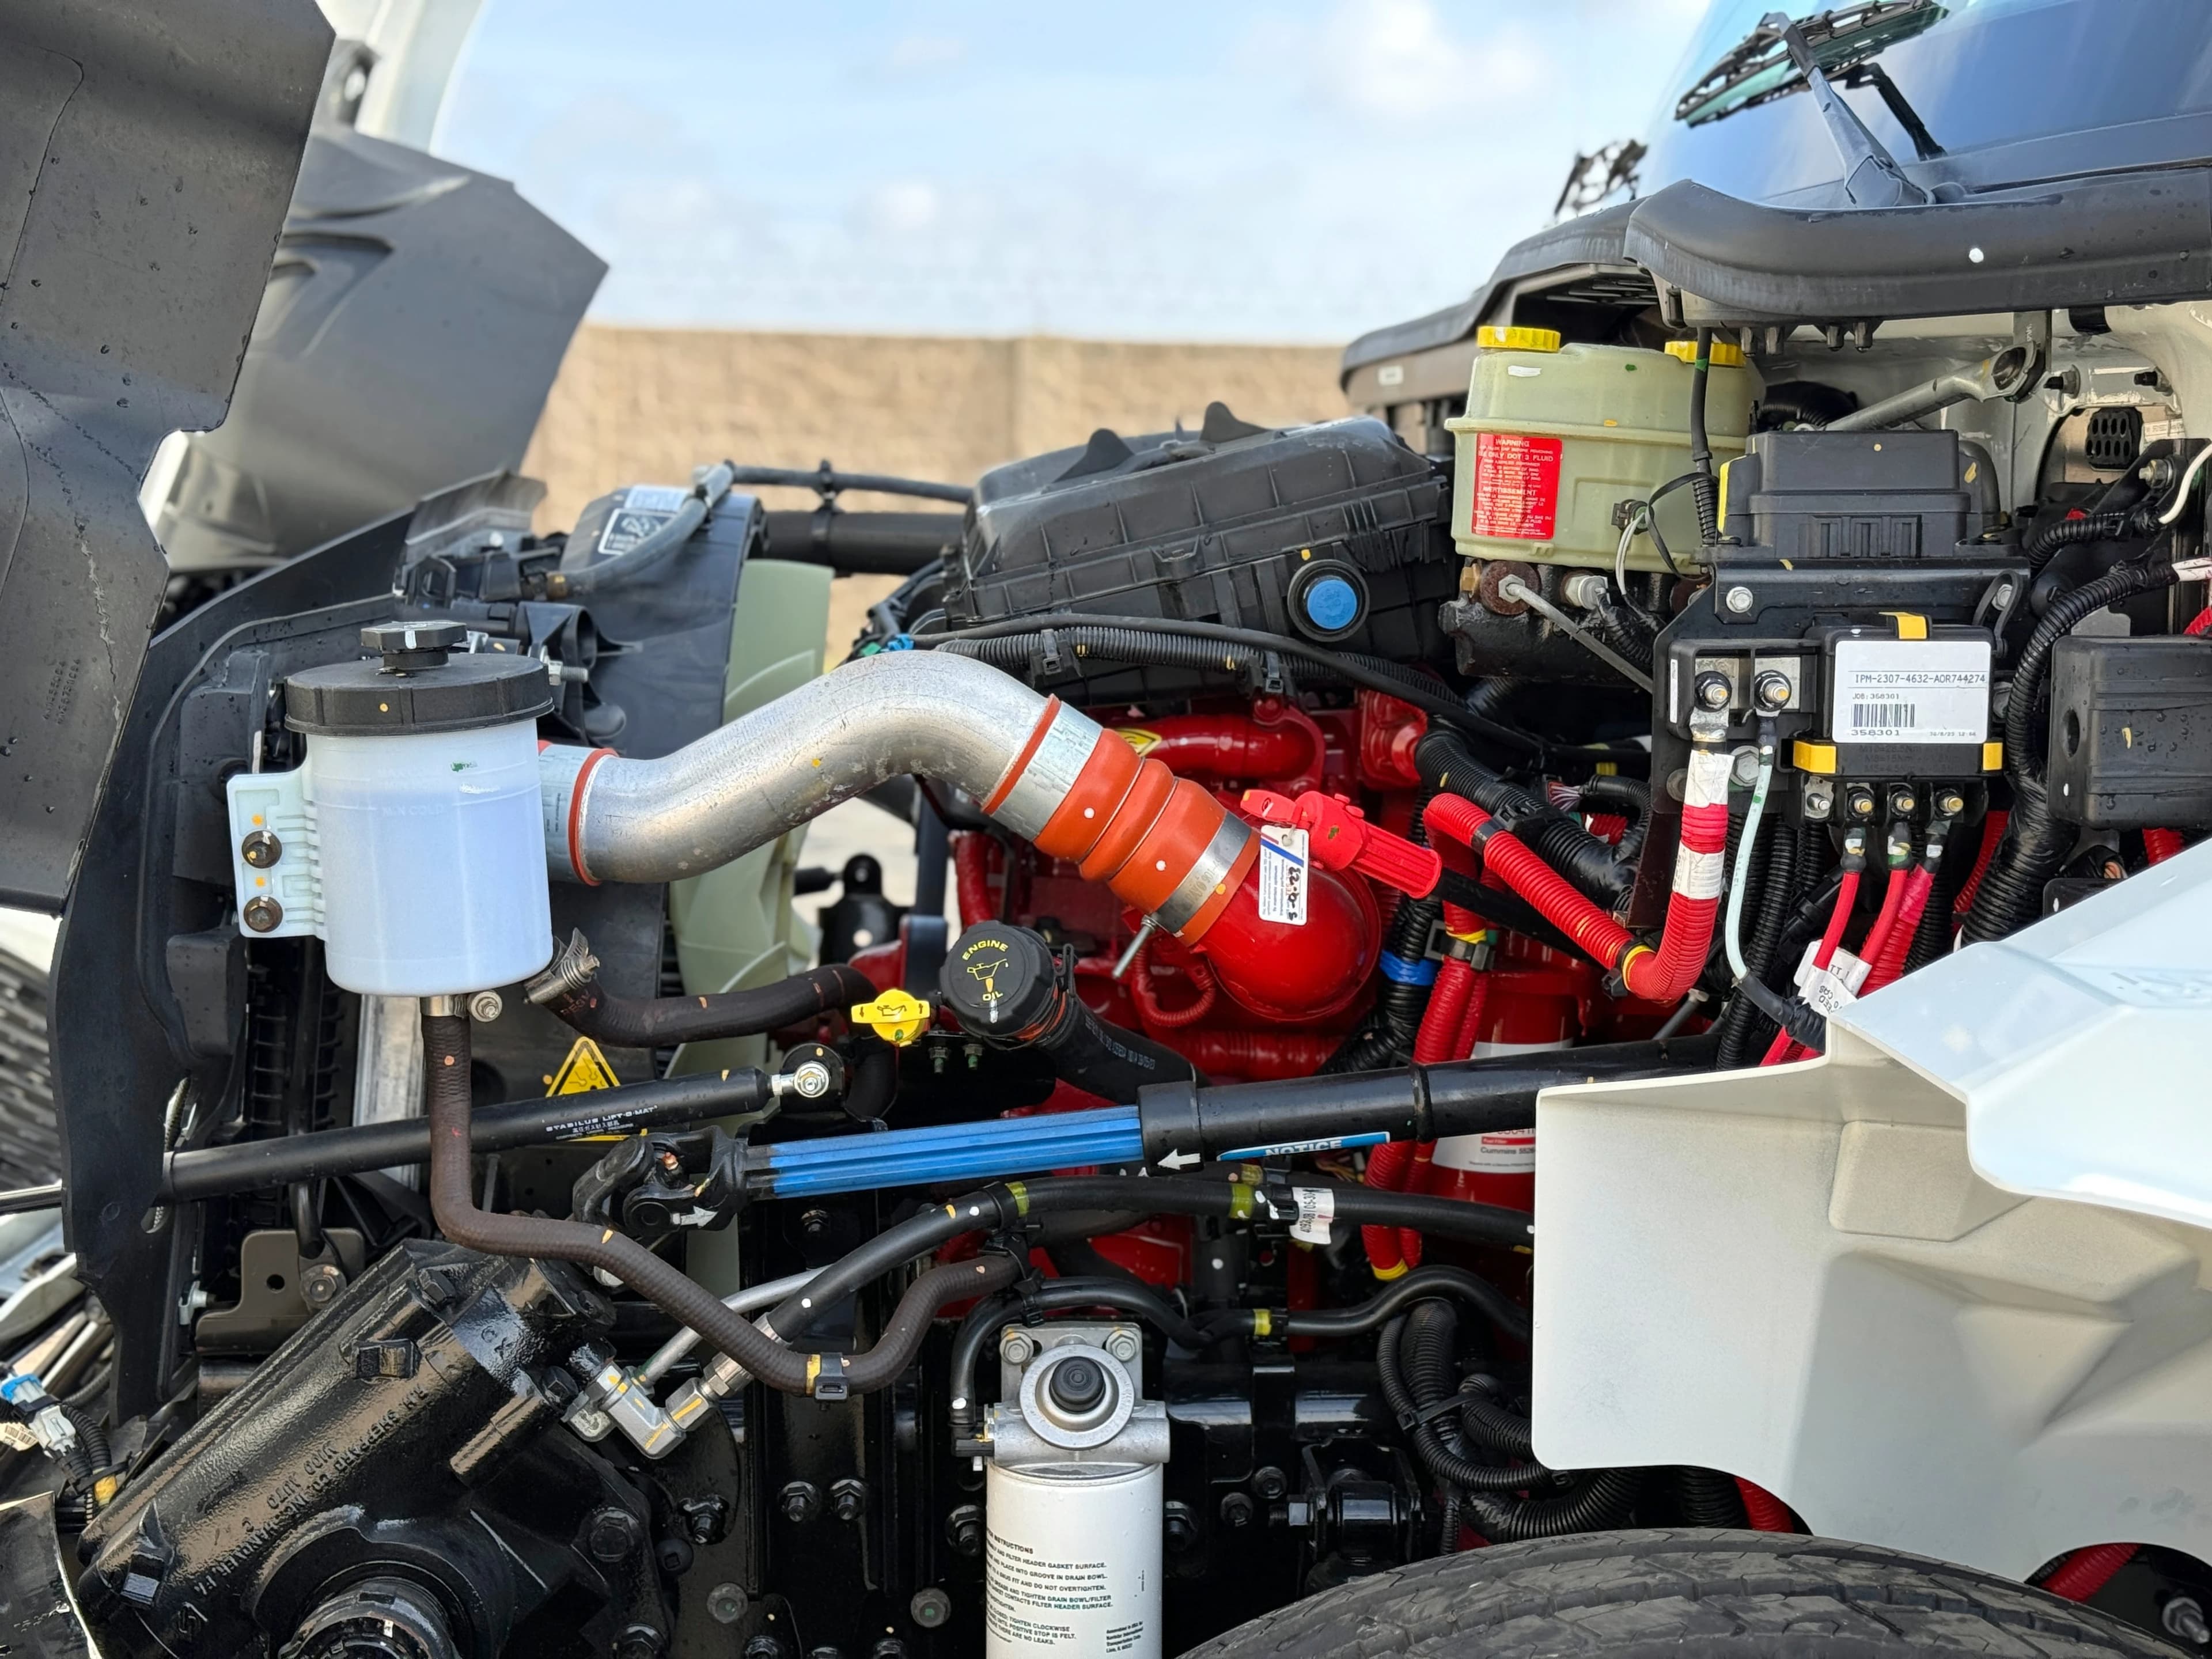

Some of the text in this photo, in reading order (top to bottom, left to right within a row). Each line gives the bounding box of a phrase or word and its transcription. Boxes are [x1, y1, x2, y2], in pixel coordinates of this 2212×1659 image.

[1495, 438, 1530, 447] WARNING
[962, 940, 1009, 961] ENGINE
[982, 990, 1003, 1001] OIL
[546, 1117, 600, 1132] STABILUS
[1265, 1139, 1342, 1157] NOTICE
[1480, 1146, 1517, 1154] Cummins
[333, 1409, 400, 1472] SHEPPARD
[994, 1535, 1033, 1554] INSTRUCTIONS
[1006, 1553, 1021, 1563] FILTER
[1022, 1558, 1046, 1567] HEADER
[1075, 1562, 1107, 1570] SURFACE.
[1001, 1560, 1014, 1571] PLACE
[1016, 1567, 1028, 1575] INTO
[1029, 1571, 1055, 1580] GROOVE
[1059, 1584, 1107, 1592] OVERTIGHTEN.
[1004, 1592, 1031, 1605] CONTACTS
[1032, 1600, 1052, 1608] FILTER
[1082, 1601, 1113, 1610] SURFACE.
[1021, 1590, 1046, 1601] TIGHTEN
[1069, 1594, 1112, 1603] BOWL/FILTER
[1009, 1616, 1031, 1627] TIGHTEN
[1032, 1623, 1070, 1632] CLOCKWISE
[1009, 1623, 1033, 1635] POSITIVE
[1033, 1630, 1051, 1638] STOP
[1012, 1631, 1022, 1639] ARE
[1033, 1637, 1055, 1645] LEAKS.
